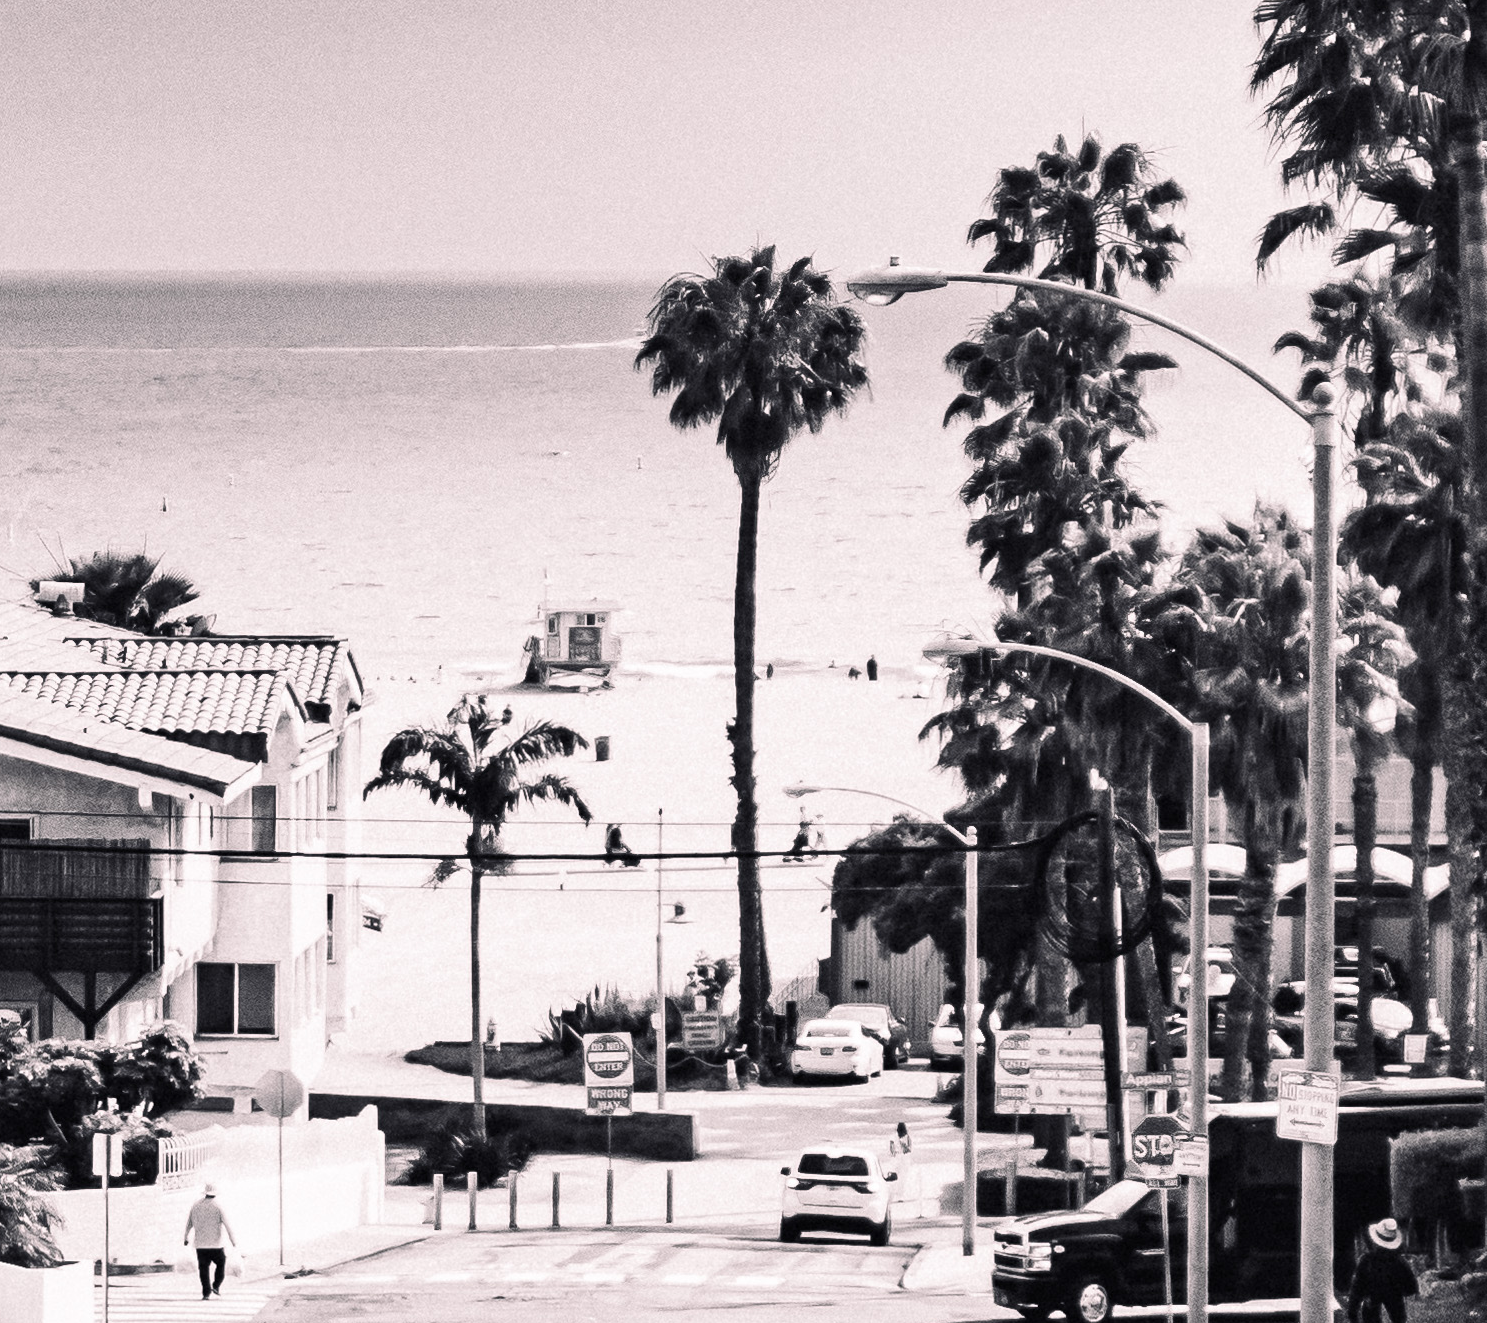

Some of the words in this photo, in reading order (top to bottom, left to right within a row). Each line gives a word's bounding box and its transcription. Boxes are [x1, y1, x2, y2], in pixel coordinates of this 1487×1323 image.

[591, 1043, 604, 1051] DO
[594, 1062, 623, 1071] ENTER
[1125, 1073, 1172, 1087] Appian
[591, 1088, 628, 1099] WRONG
[1287, 1105, 1304, 1115] ANY
[1310, 1106, 1328, 1118] TIME
[1133, 1134, 1174, 1158] STO
